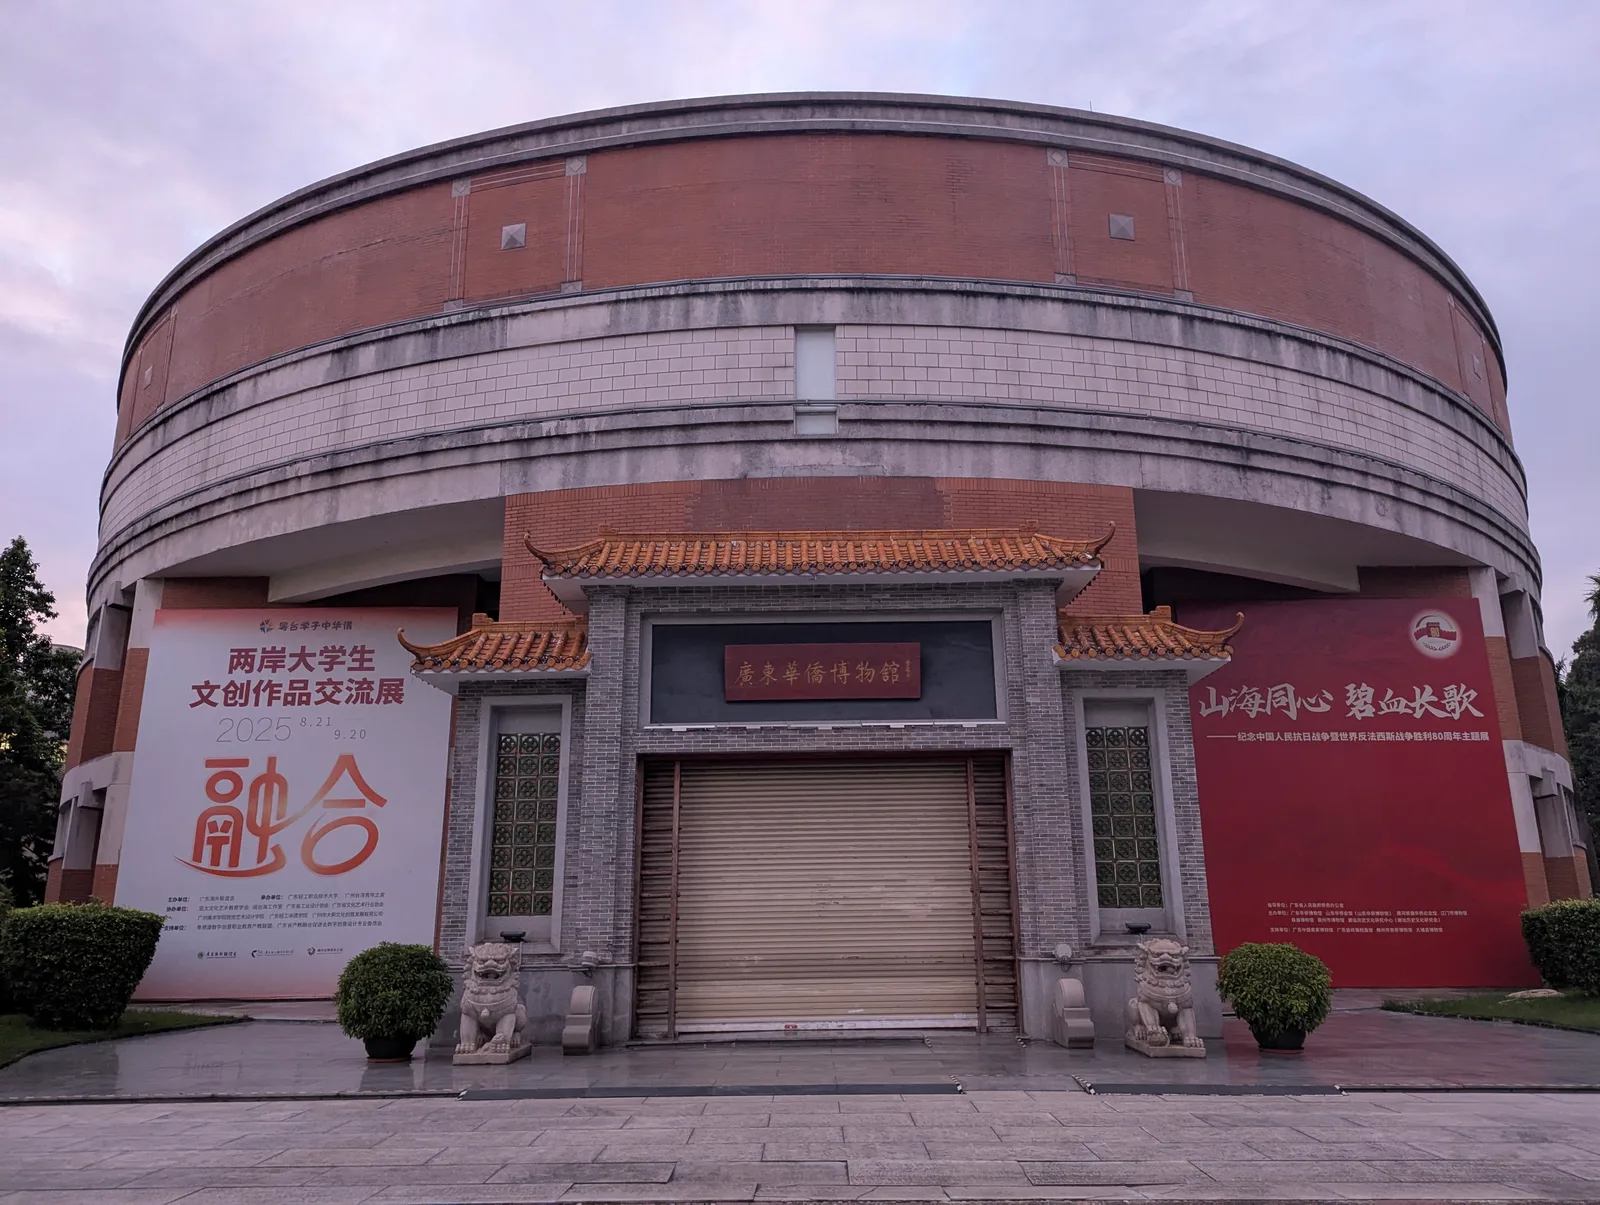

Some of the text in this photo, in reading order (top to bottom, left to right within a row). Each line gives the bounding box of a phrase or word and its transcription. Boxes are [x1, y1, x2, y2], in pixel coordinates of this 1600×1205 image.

[227, 644, 376, 675] 两岸大学生
[189, 677, 405, 708] 文创作品交流展
[1198, 682, 1485, 721] 山海同心 碧血长歌
[216, 716, 292, 743] 2025
[299, 716, 332, 727] 8.21
[334, 729, 367, 740] 9.20
[172, 753, 388, 879] 融合
